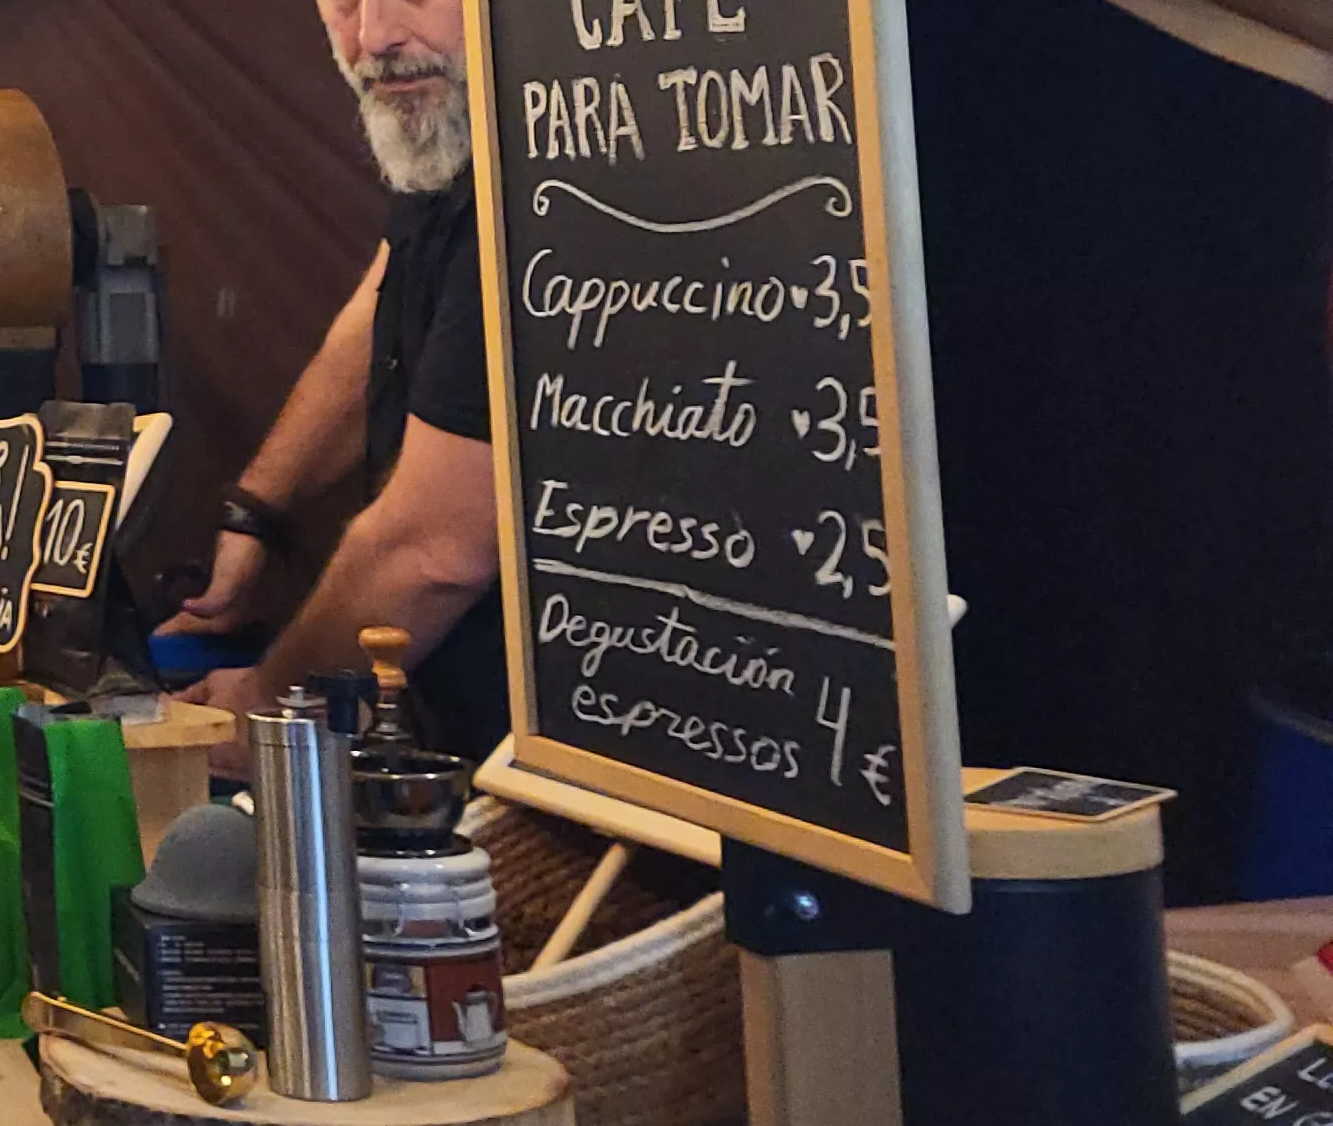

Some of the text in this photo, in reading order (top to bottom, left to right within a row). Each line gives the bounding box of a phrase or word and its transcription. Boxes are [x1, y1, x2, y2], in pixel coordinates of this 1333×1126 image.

[522, 53, 852, 164] PARA TOMAR
[522, 248, 784, 349] Cappuccino
[530, 360, 757, 447] Macchiato
[533, 480, 757, 569] Espresso
[539, 593, 797, 697] Degustación
[572, 684, 800, 779] espressos
[816, 677, 851, 787] 4
